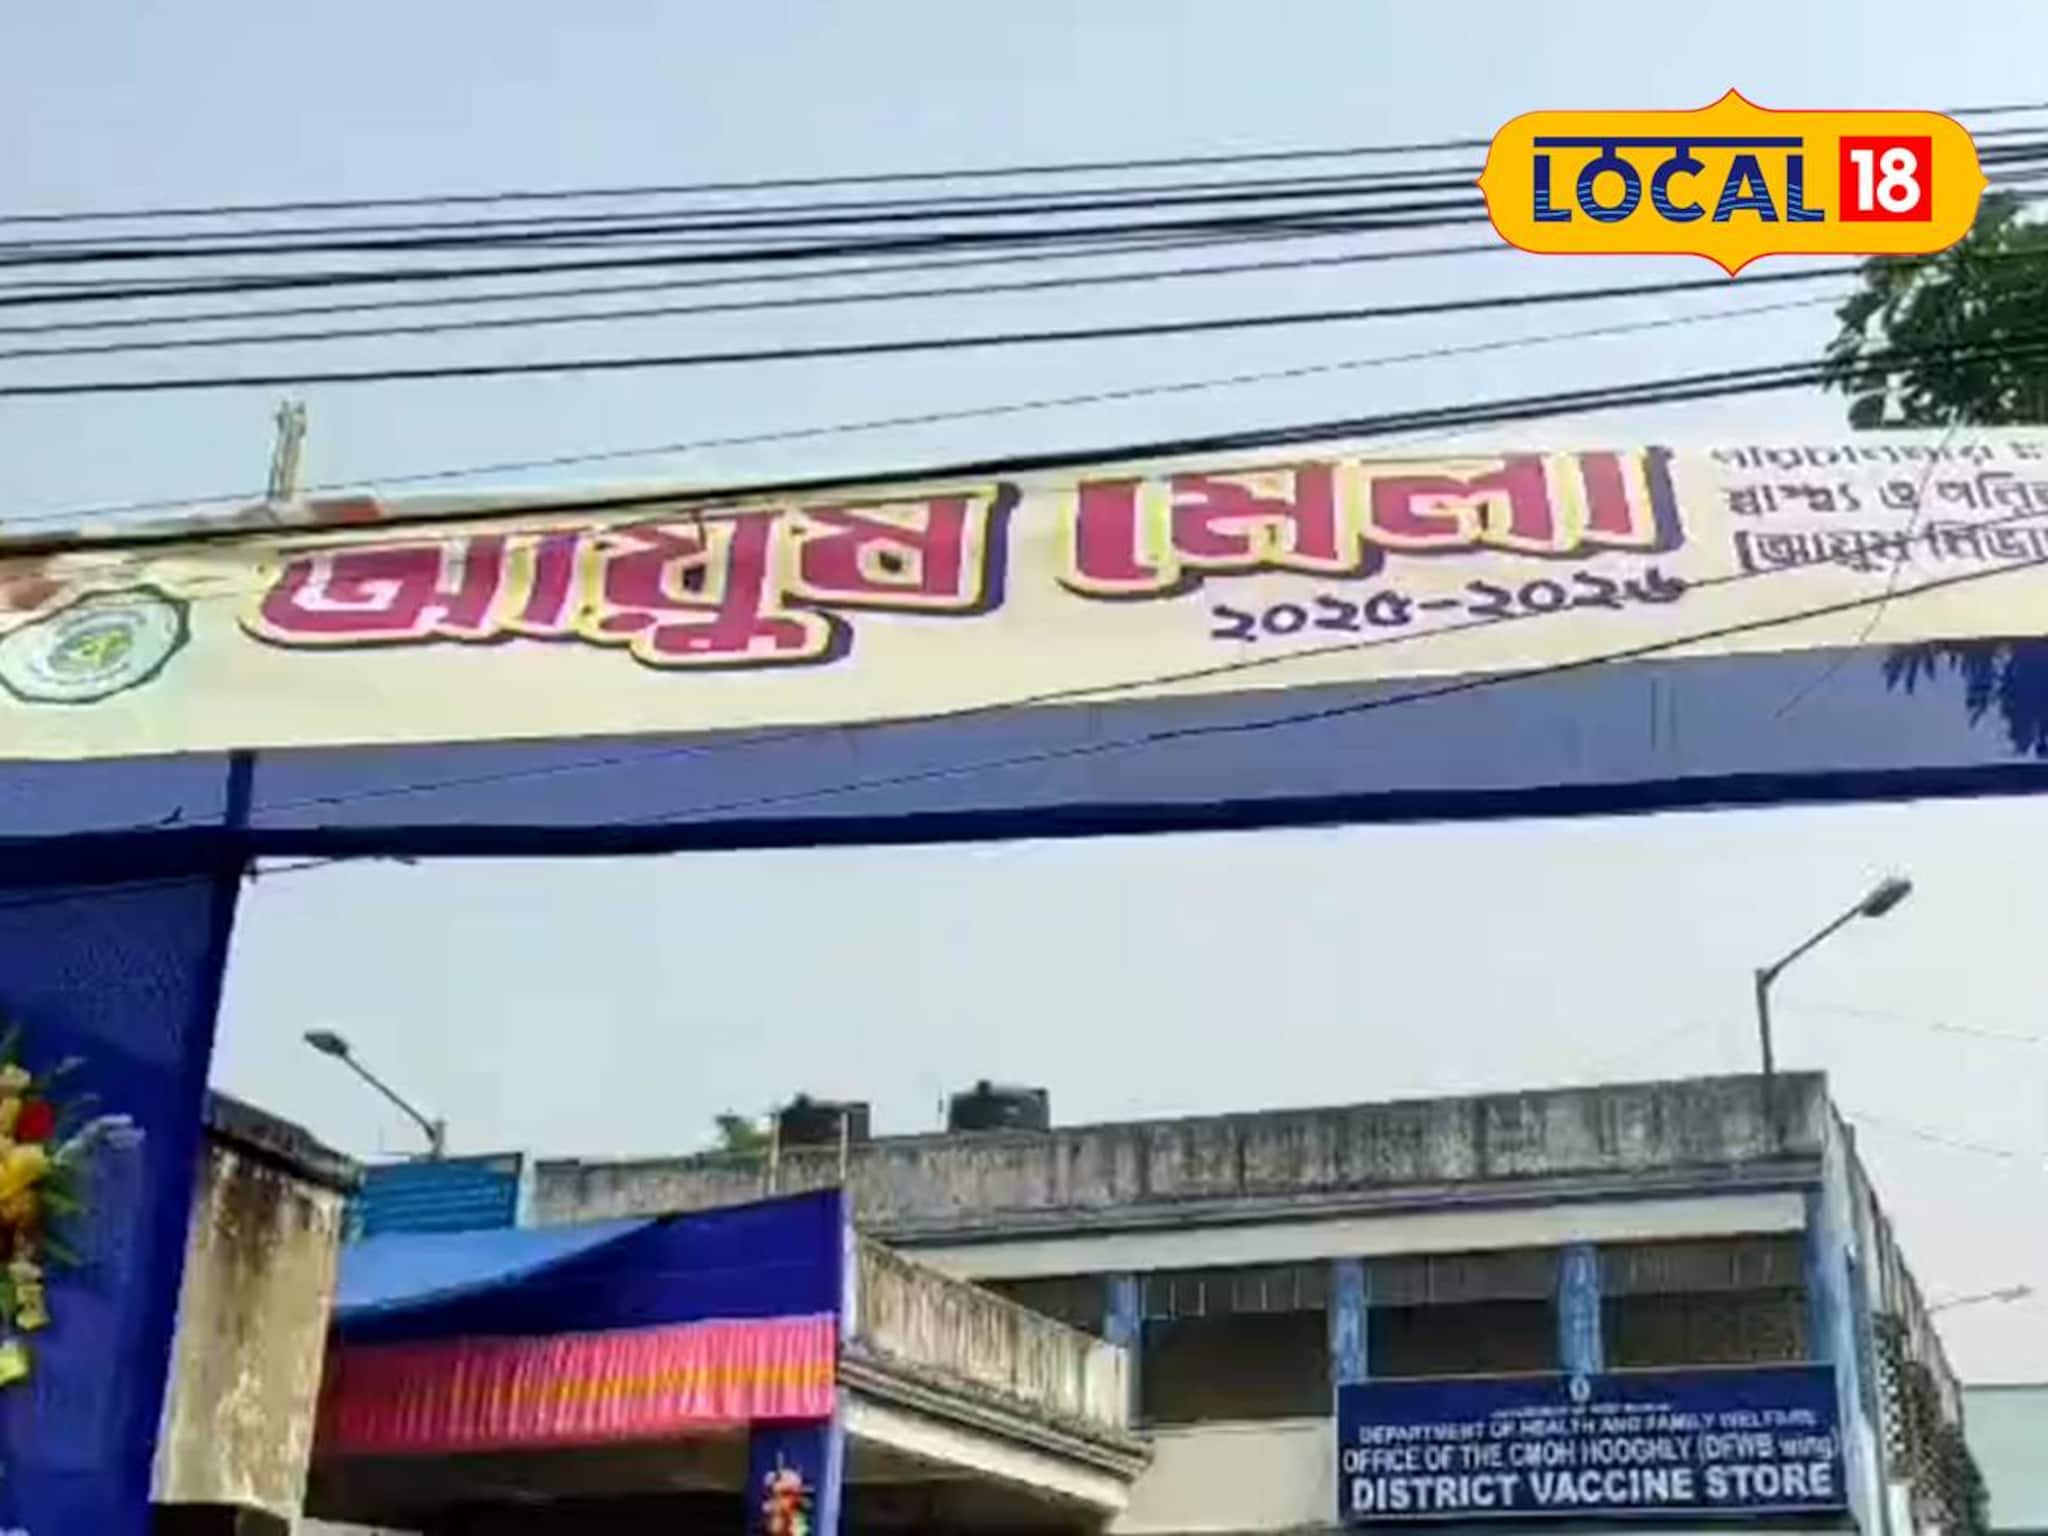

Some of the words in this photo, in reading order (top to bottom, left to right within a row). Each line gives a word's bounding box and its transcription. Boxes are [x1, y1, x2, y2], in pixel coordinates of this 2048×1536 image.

[1879, 480, 1917, 509] ও
[243, 484, 1014, 669] আয়ুষ
[1062, 447, 1684, 598] মেলা
[1211, 566, 1685, 641] ২০২৫-২০২৬
[1491, 1420, 1517, 1439] OF
[1520, 1418, 1596, 1438] HEALTH
[1343, 1446, 1420, 1473] OFFICE
[1424, 1445, 1454, 1471] OF
[1459, 1443, 1505, 1469] THE
[1509, 1441, 1575, 1467] CMOH
[1581, 1435, 1692, 1465] HOOGHLY
[1351, 1473, 1519, 1512] DISTRICT
[1529, 1467, 1694, 1503] VACCINE
[1705, 1462, 1833, 1499] STORE
